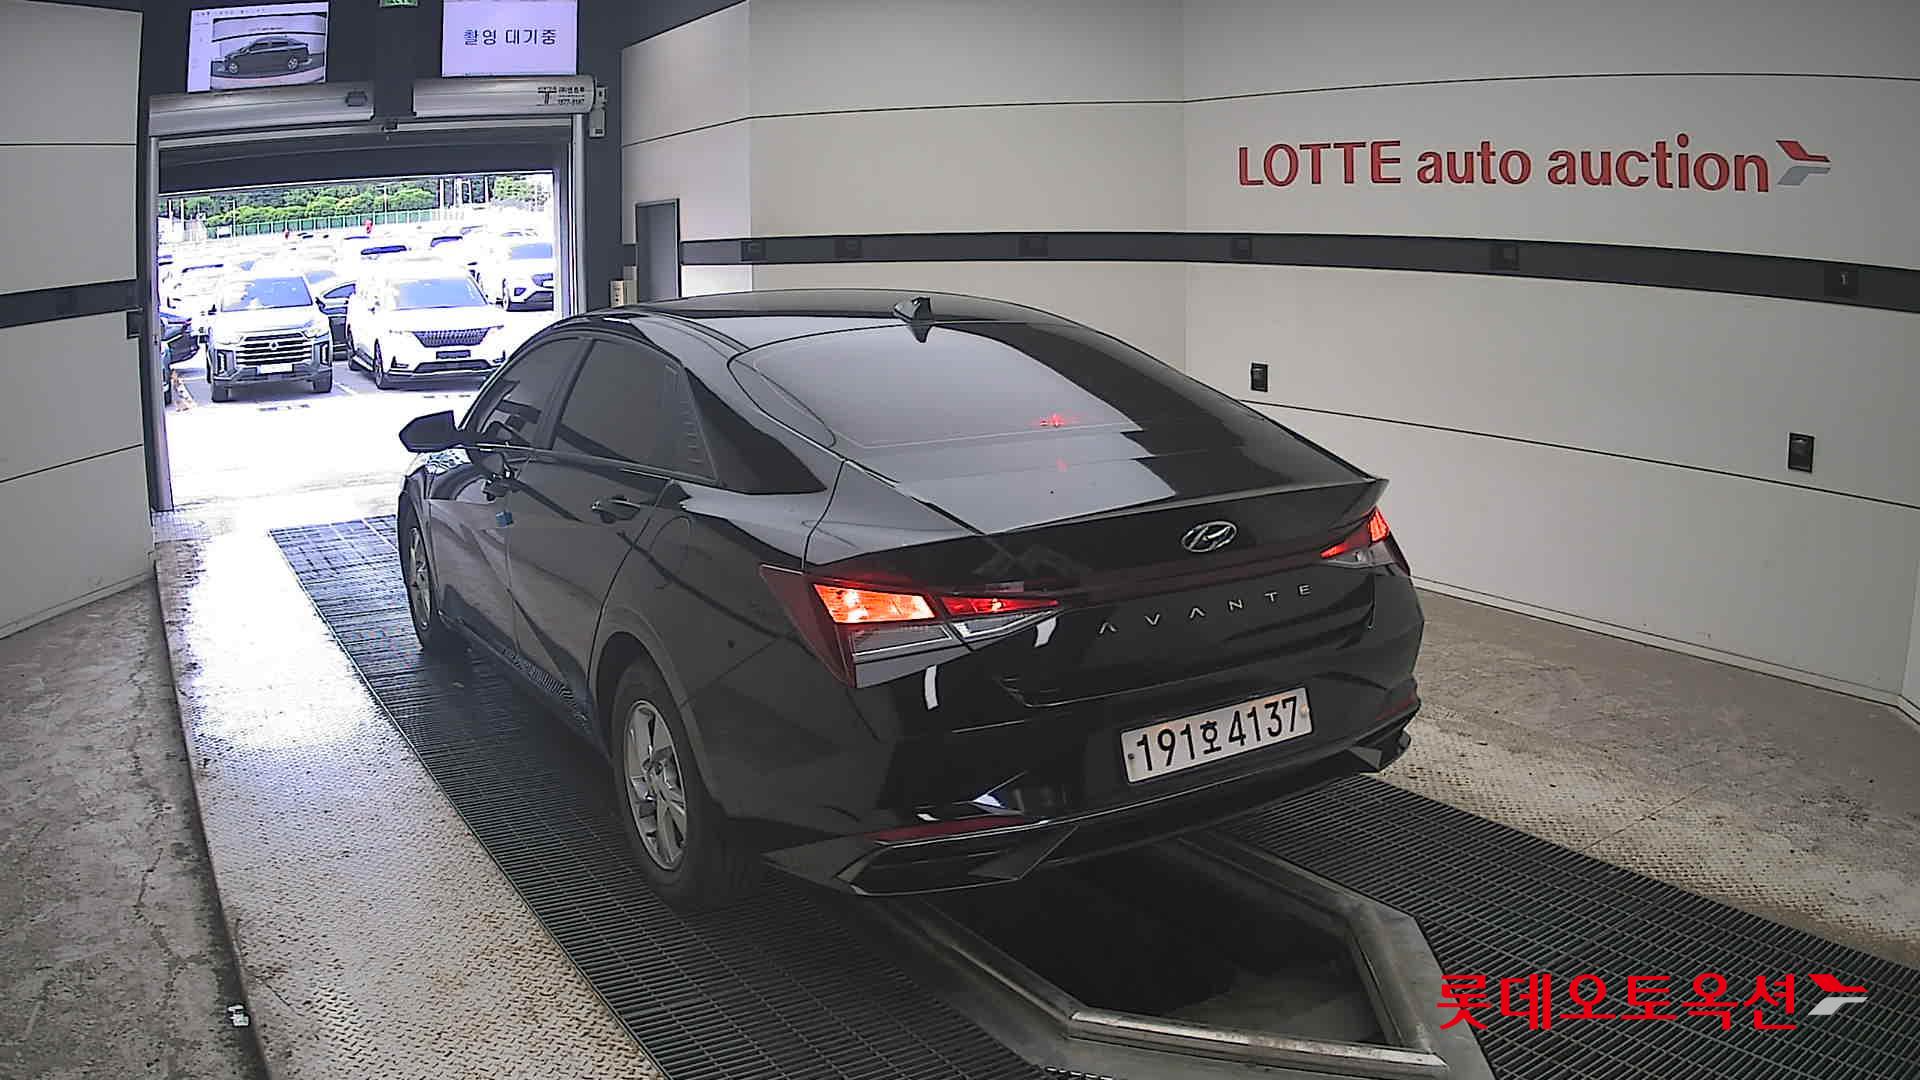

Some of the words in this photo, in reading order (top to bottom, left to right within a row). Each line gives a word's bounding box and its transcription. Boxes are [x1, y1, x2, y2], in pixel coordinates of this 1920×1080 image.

[464, 28, 497, 46] 촬영
[505, 29, 557, 46] 대기중
[1238, 139, 1402, 187] LOTTE
[1416, 141, 1532, 185] auto
[1547, 133, 1770, 193] auction
[1099, 584, 1312, 635] AVANTE
[1136, 696, 1298, 772] 191호4137
